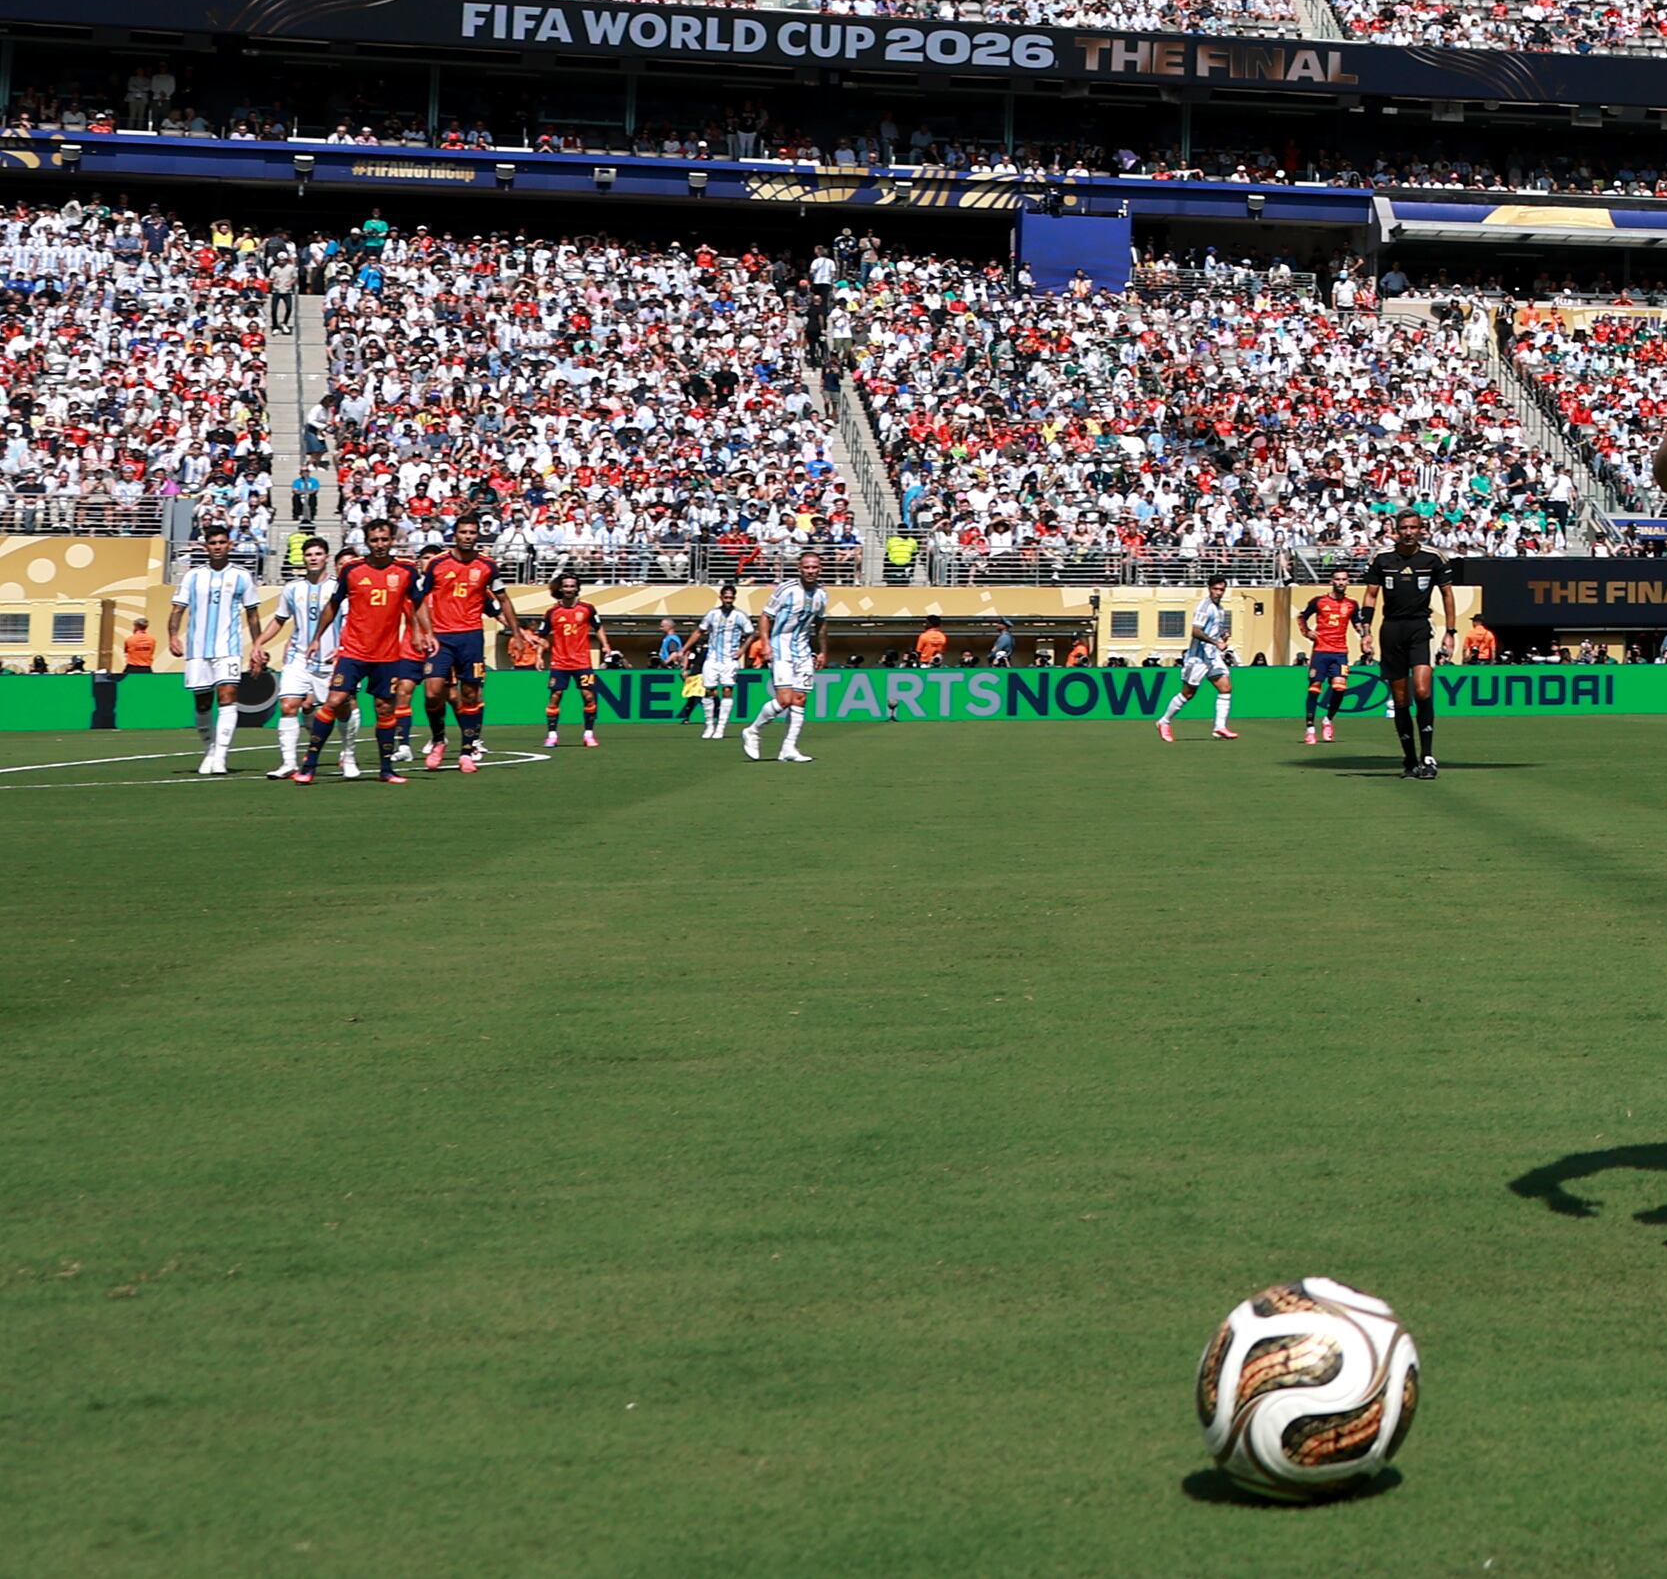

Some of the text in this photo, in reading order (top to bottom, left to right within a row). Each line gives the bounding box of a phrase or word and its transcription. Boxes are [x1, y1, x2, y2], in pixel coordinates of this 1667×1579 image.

[461, 2, 1359, 86] FIFA WORLD CUP 2026 THE FINAL
[370, 589, 388, 606] 21
[452, 582, 468, 598] 16
[1527, 580, 1598, 604] THE
[226, 662, 239, 677] 13
[580, 673, 595, 687] 24
[1436, 674, 1615, 707] YUNDAI
